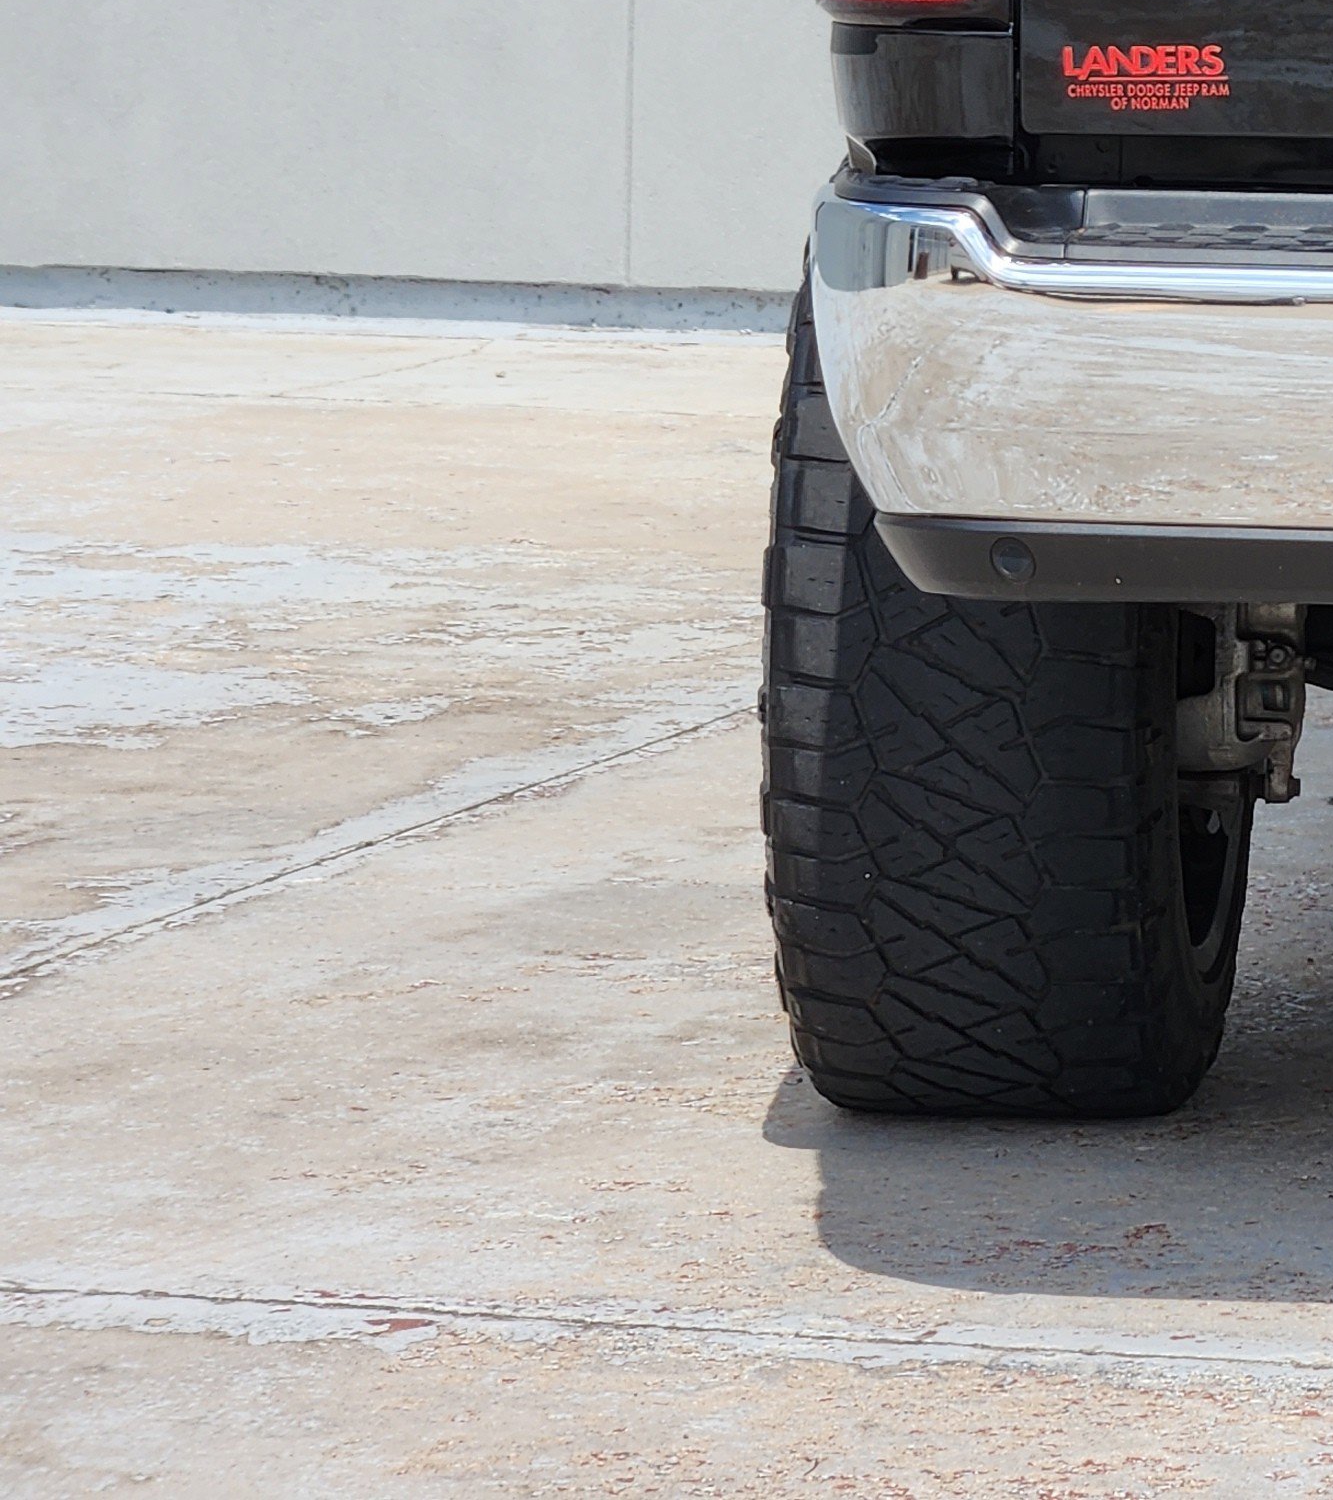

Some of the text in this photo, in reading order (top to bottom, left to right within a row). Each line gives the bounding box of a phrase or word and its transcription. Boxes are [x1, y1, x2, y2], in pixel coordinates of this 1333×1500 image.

[1062, 45, 1224, 80] LANDERS
[1067, 83, 1230, 97] CHRYSLER DODGE JEEP RAM
[1111, 97, 1189, 110] OF NORMAN
